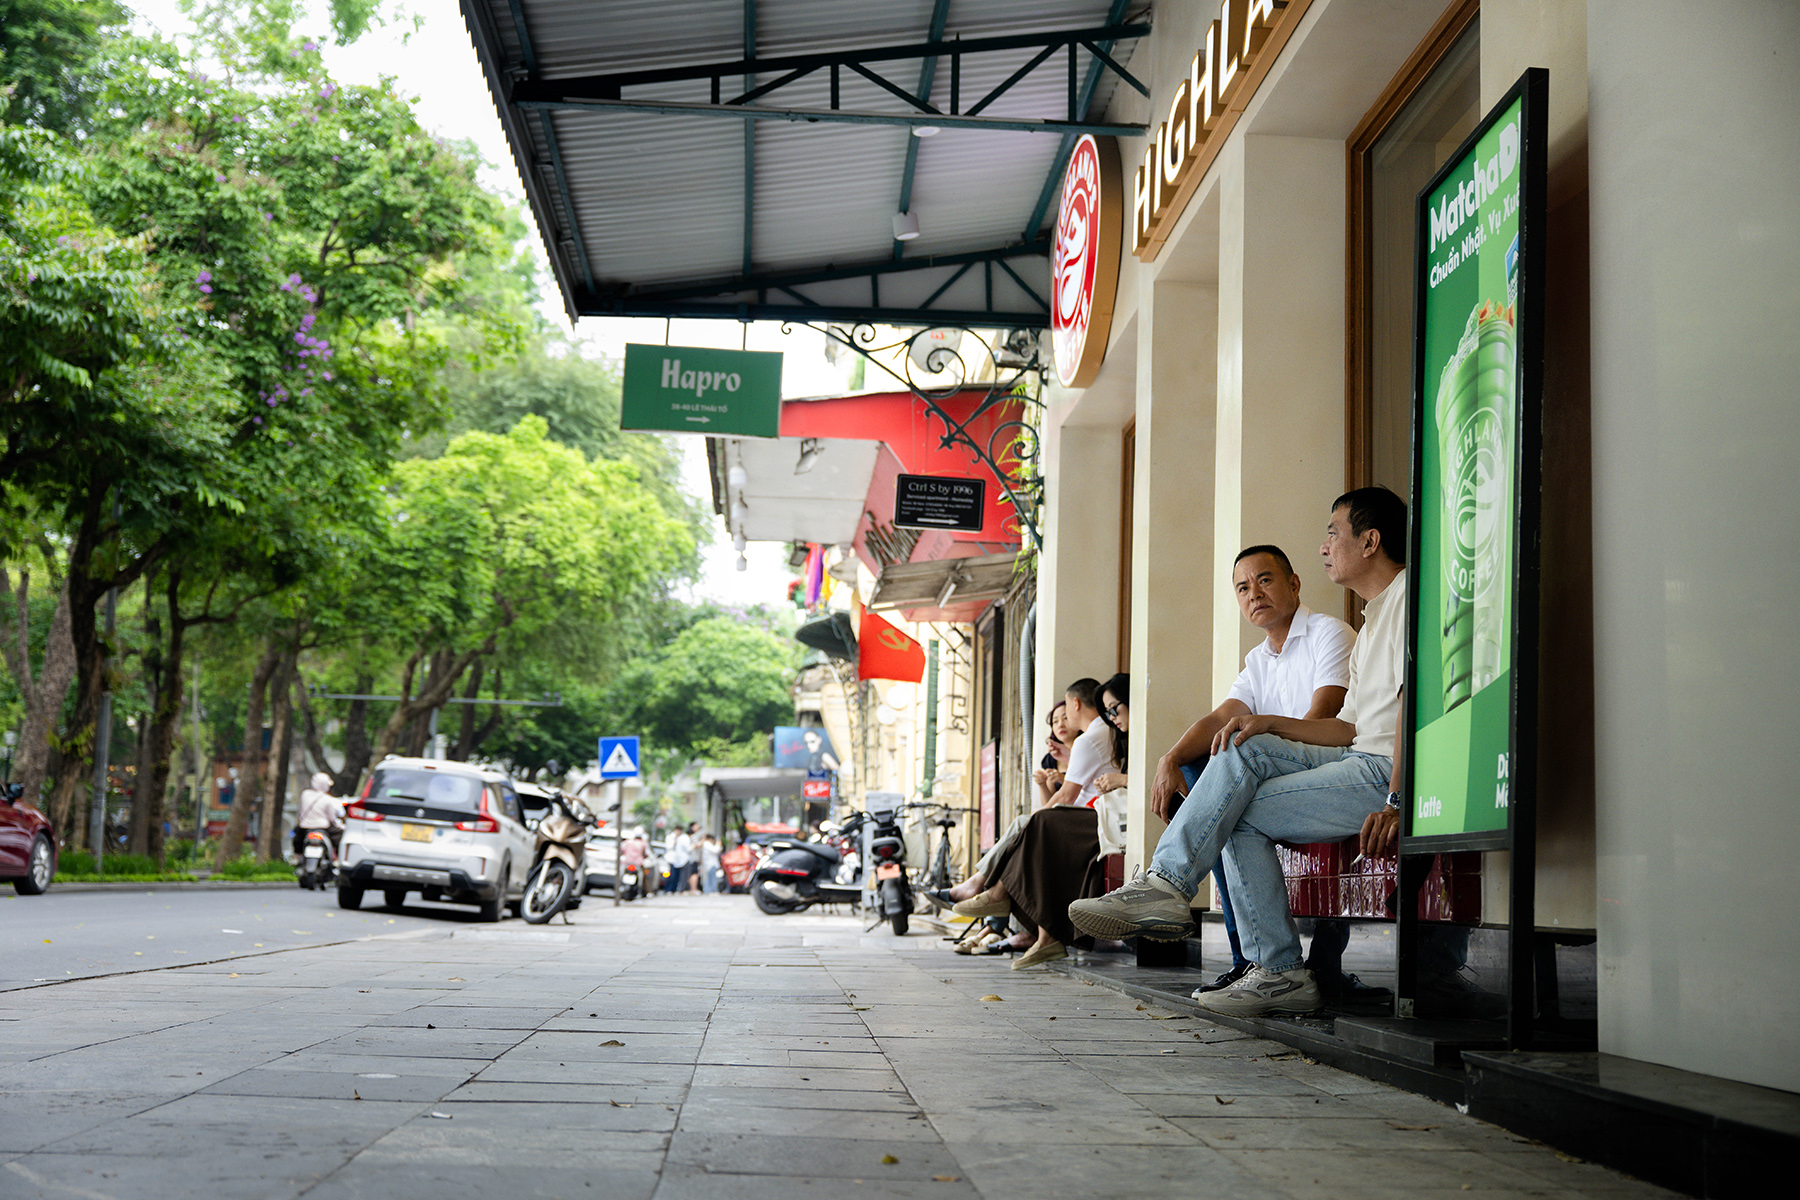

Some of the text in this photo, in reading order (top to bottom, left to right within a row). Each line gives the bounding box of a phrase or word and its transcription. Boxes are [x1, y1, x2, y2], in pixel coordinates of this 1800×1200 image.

[1430, 246, 1460, 289] Chuẩn
[1488, 209, 1502, 235] Vụ
[661, 359, 741, 397] Hapro
[908, 482, 973, 495] Ctrl S by 1996
[1451, 538, 1499, 591] COFFEE
[1418, 795, 1442, 819] Latte
